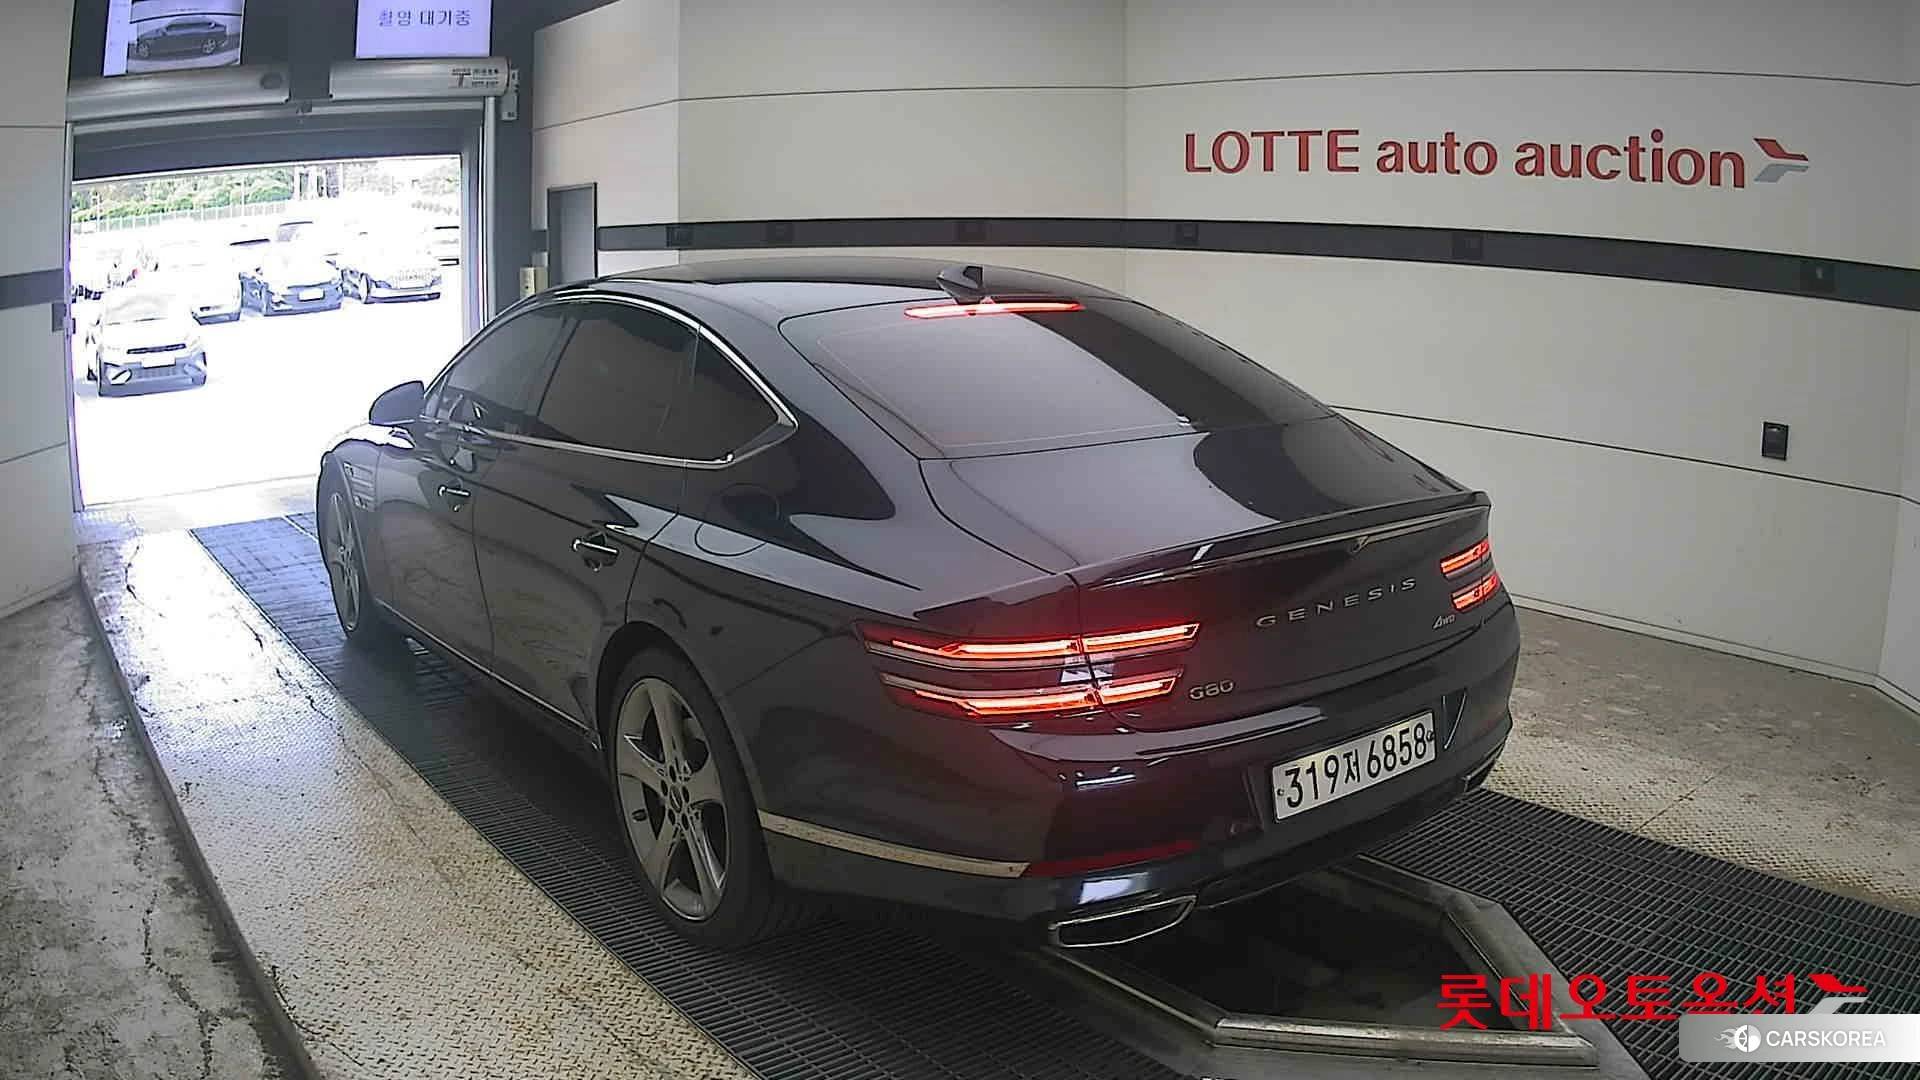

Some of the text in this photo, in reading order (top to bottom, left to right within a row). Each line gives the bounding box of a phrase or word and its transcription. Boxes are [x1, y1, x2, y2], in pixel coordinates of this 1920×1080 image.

[419, 9, 471, 26] 대기중
[1184, 129, 1745, 188] LOTTE auto auction
[1255, 577, 1417, 629] GENESIS
[1189, 679, 1234, 700] G80
